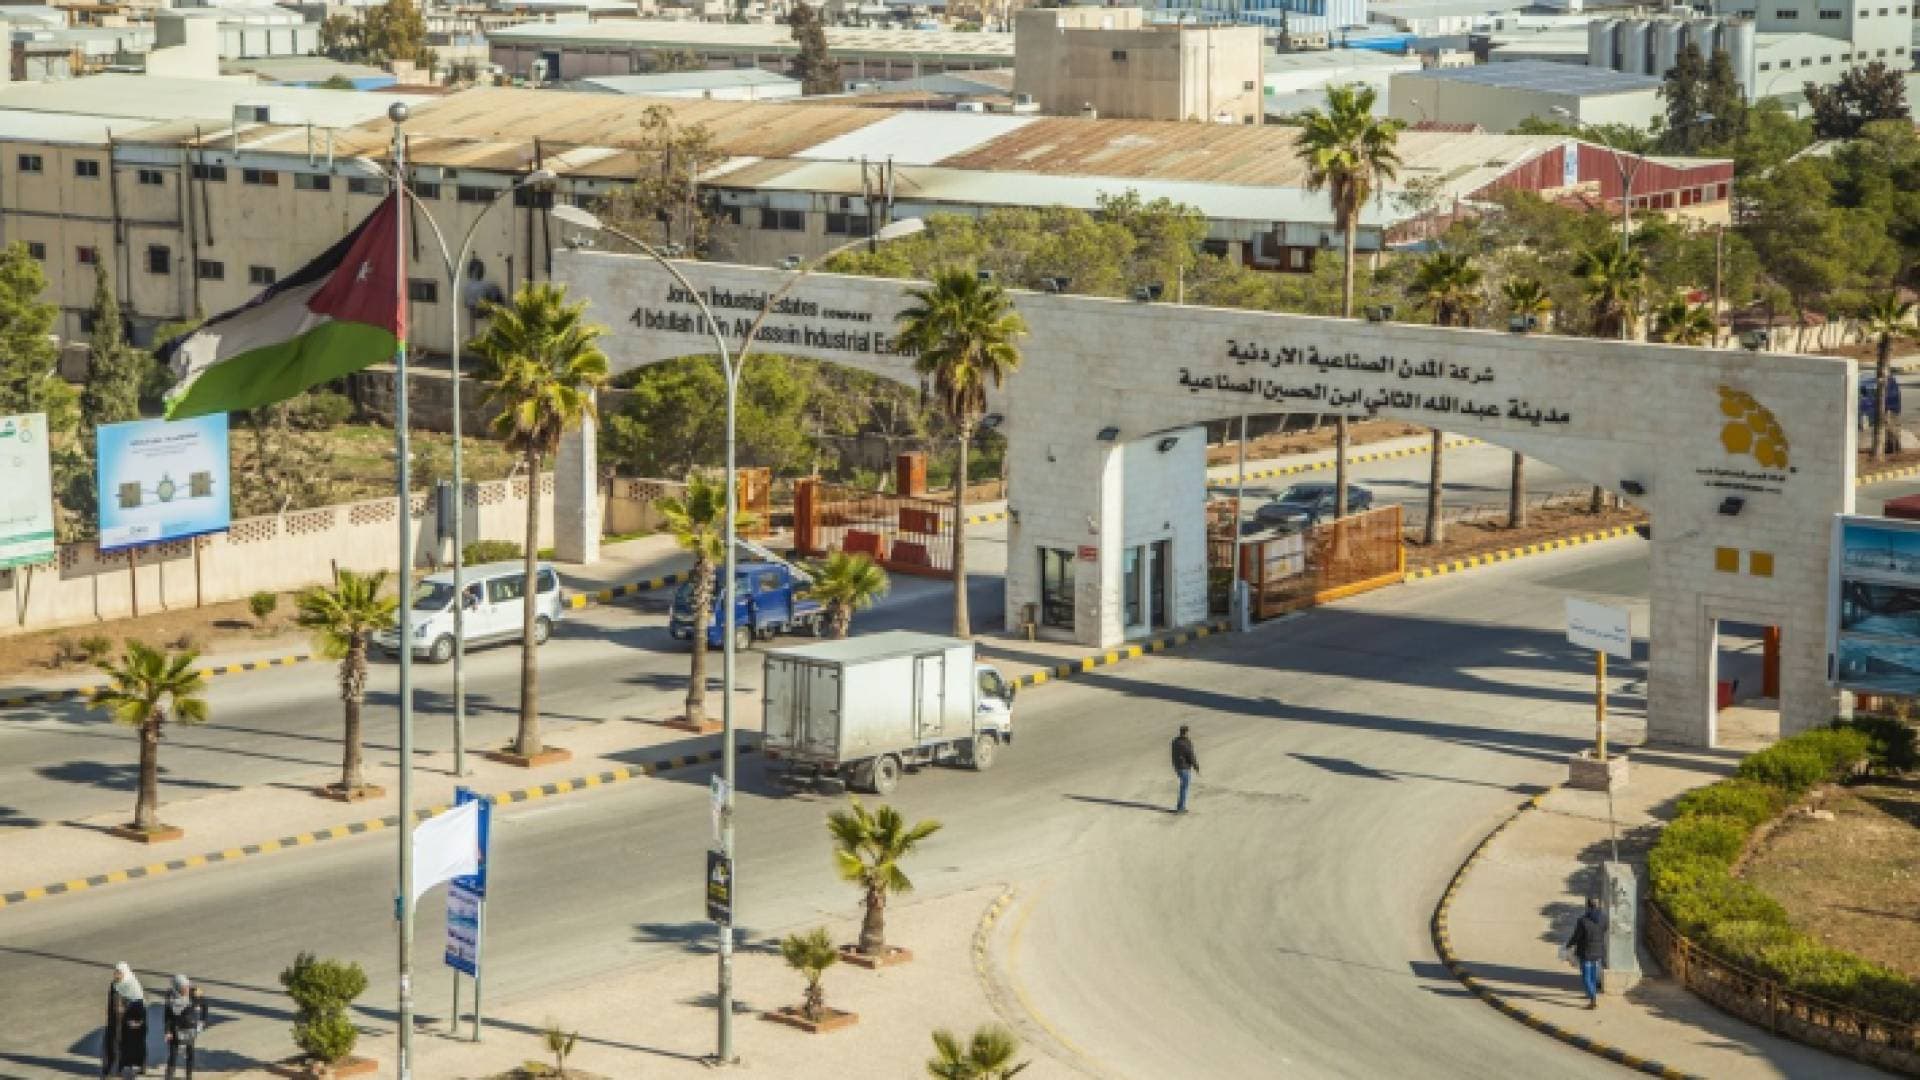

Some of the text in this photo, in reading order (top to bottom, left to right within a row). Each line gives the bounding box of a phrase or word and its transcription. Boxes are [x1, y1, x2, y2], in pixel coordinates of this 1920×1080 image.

[804, 324, 870, 351] Industrial
[1226, 339, 1495, 385] شركة المدن الصناعية الاردنية
[1178, 366, 1262, 393] الصناعية
[1263, 379, 1327, 403] الحسين
[1328, 387, 1362, 408] ابن
[1460, 399, 1501, 422] عبد
[1506, 398, 1570, 427] مدينة
